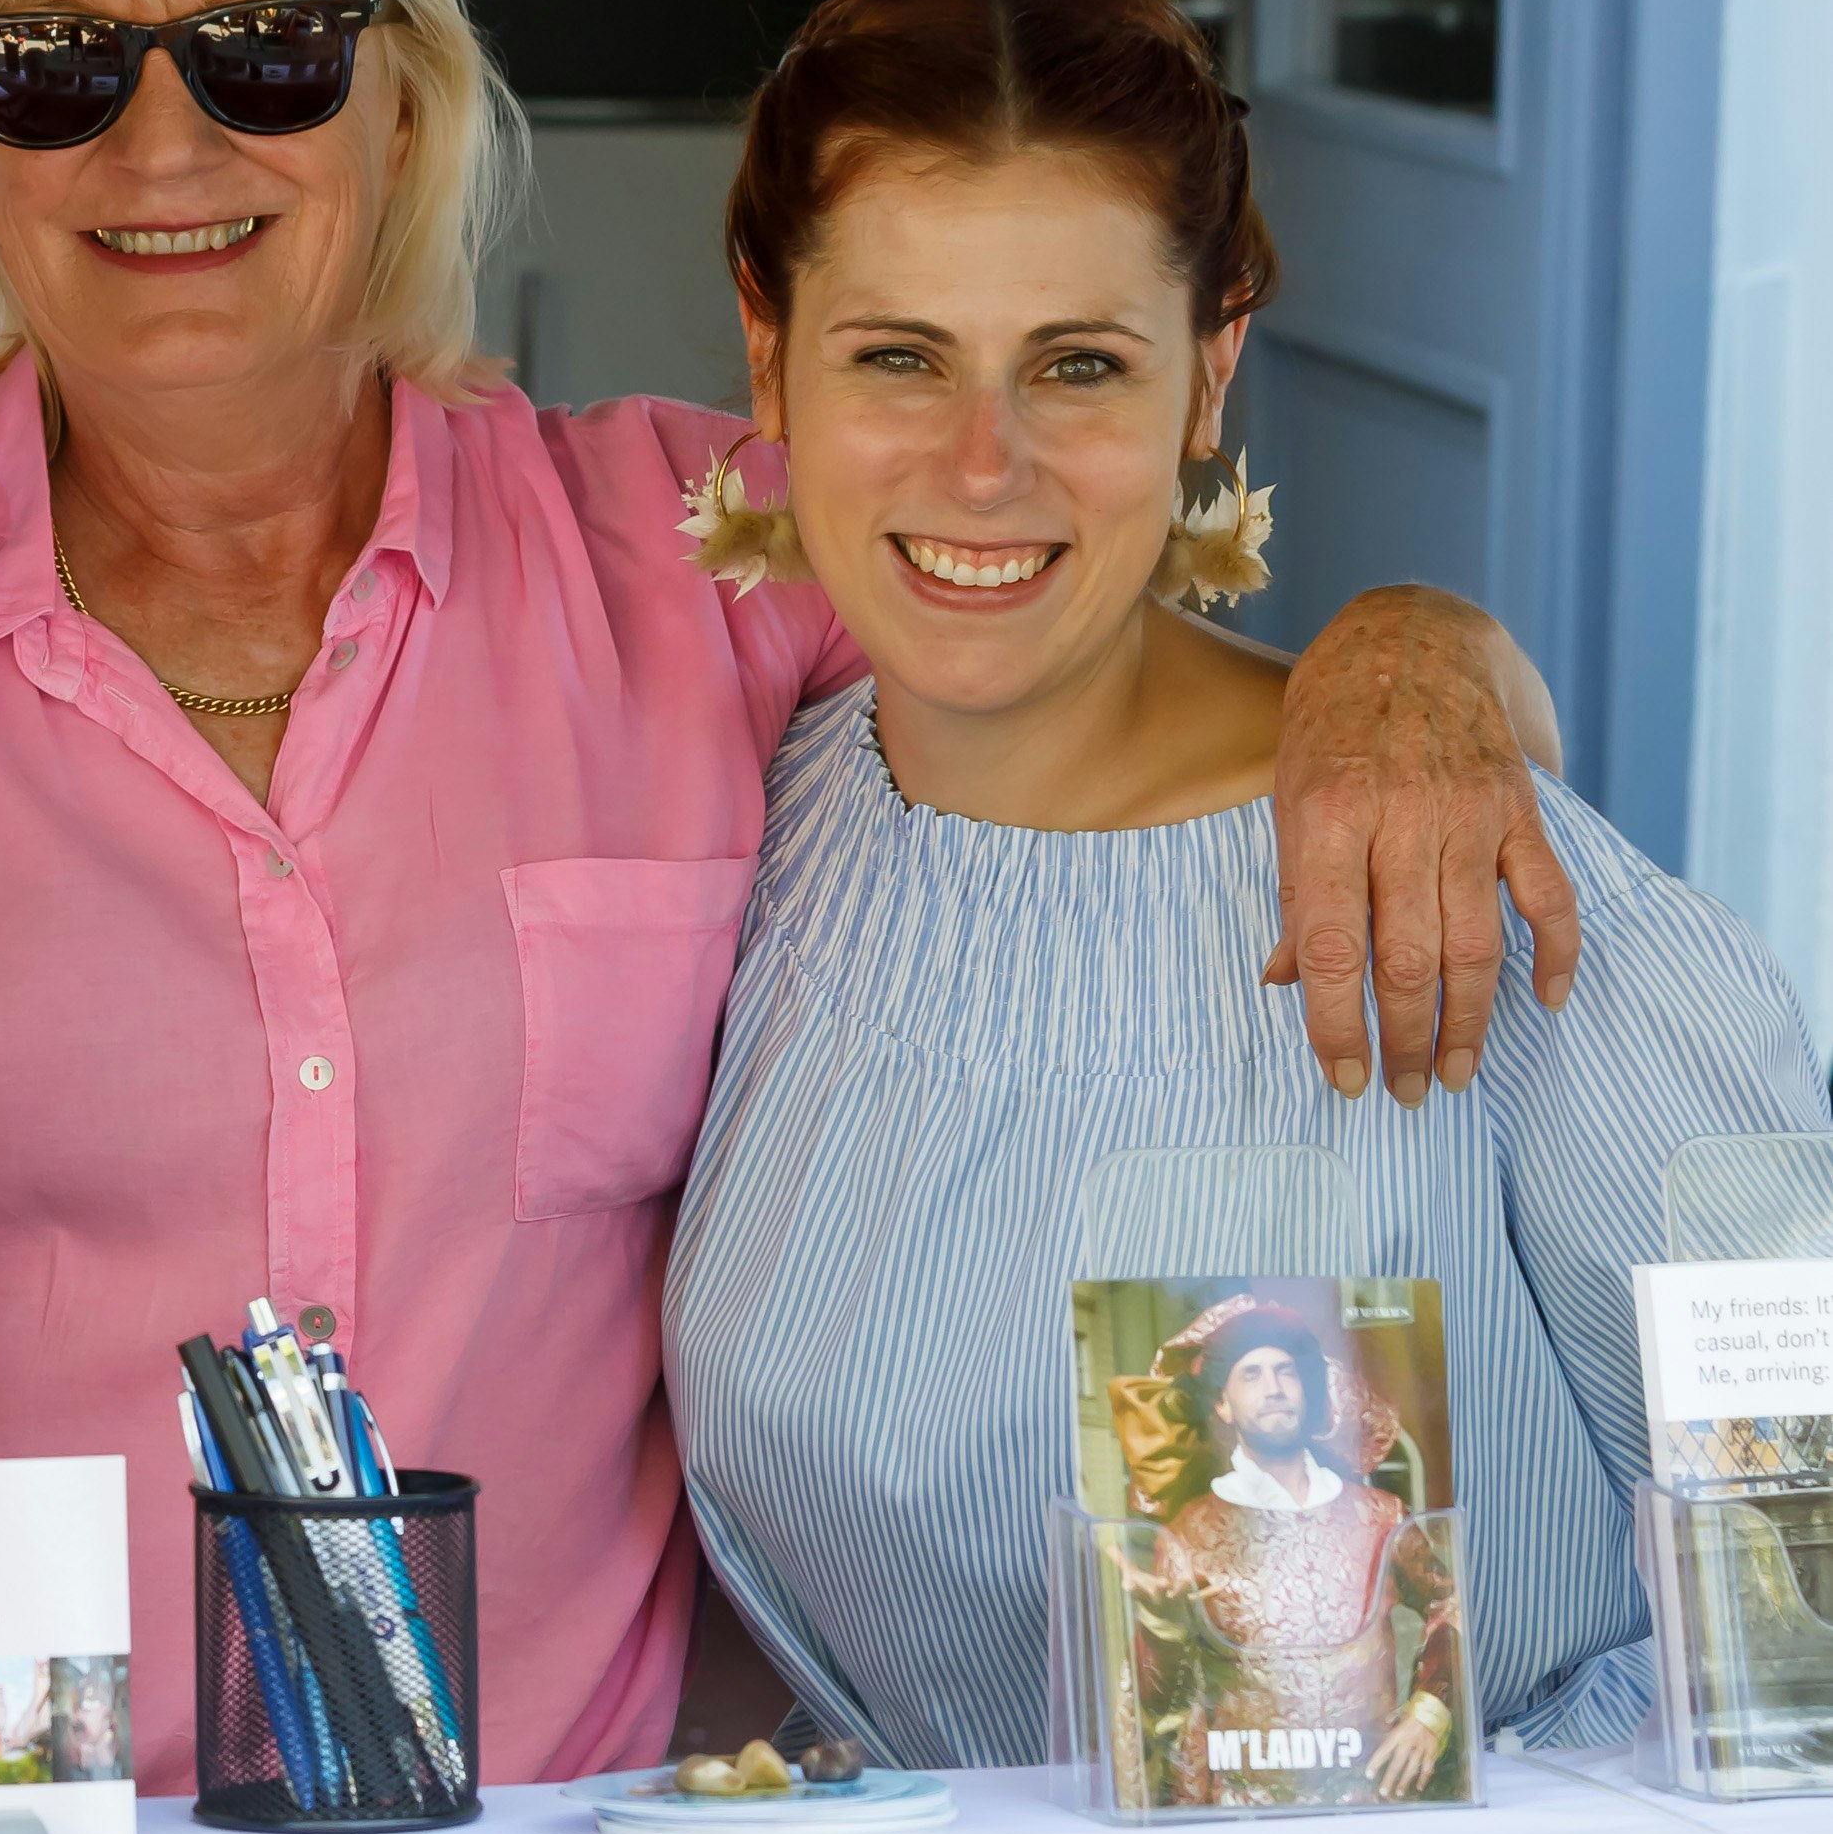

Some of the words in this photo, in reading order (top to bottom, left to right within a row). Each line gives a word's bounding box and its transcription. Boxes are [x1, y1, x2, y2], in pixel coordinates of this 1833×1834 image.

[1690, 1300, 1722, 1324] My
[1730, 1296, 1810, 1318] friends:
[1694, 1330, 1769, 1353] casual,
[1776, 1328, 1830, 1349] don't
[1698, 1364, 1738, 1386] Me,
[1745, 1361, 1831, 1386] arriving:
[1206, 1726, 1363, 1772] M'LADY?
